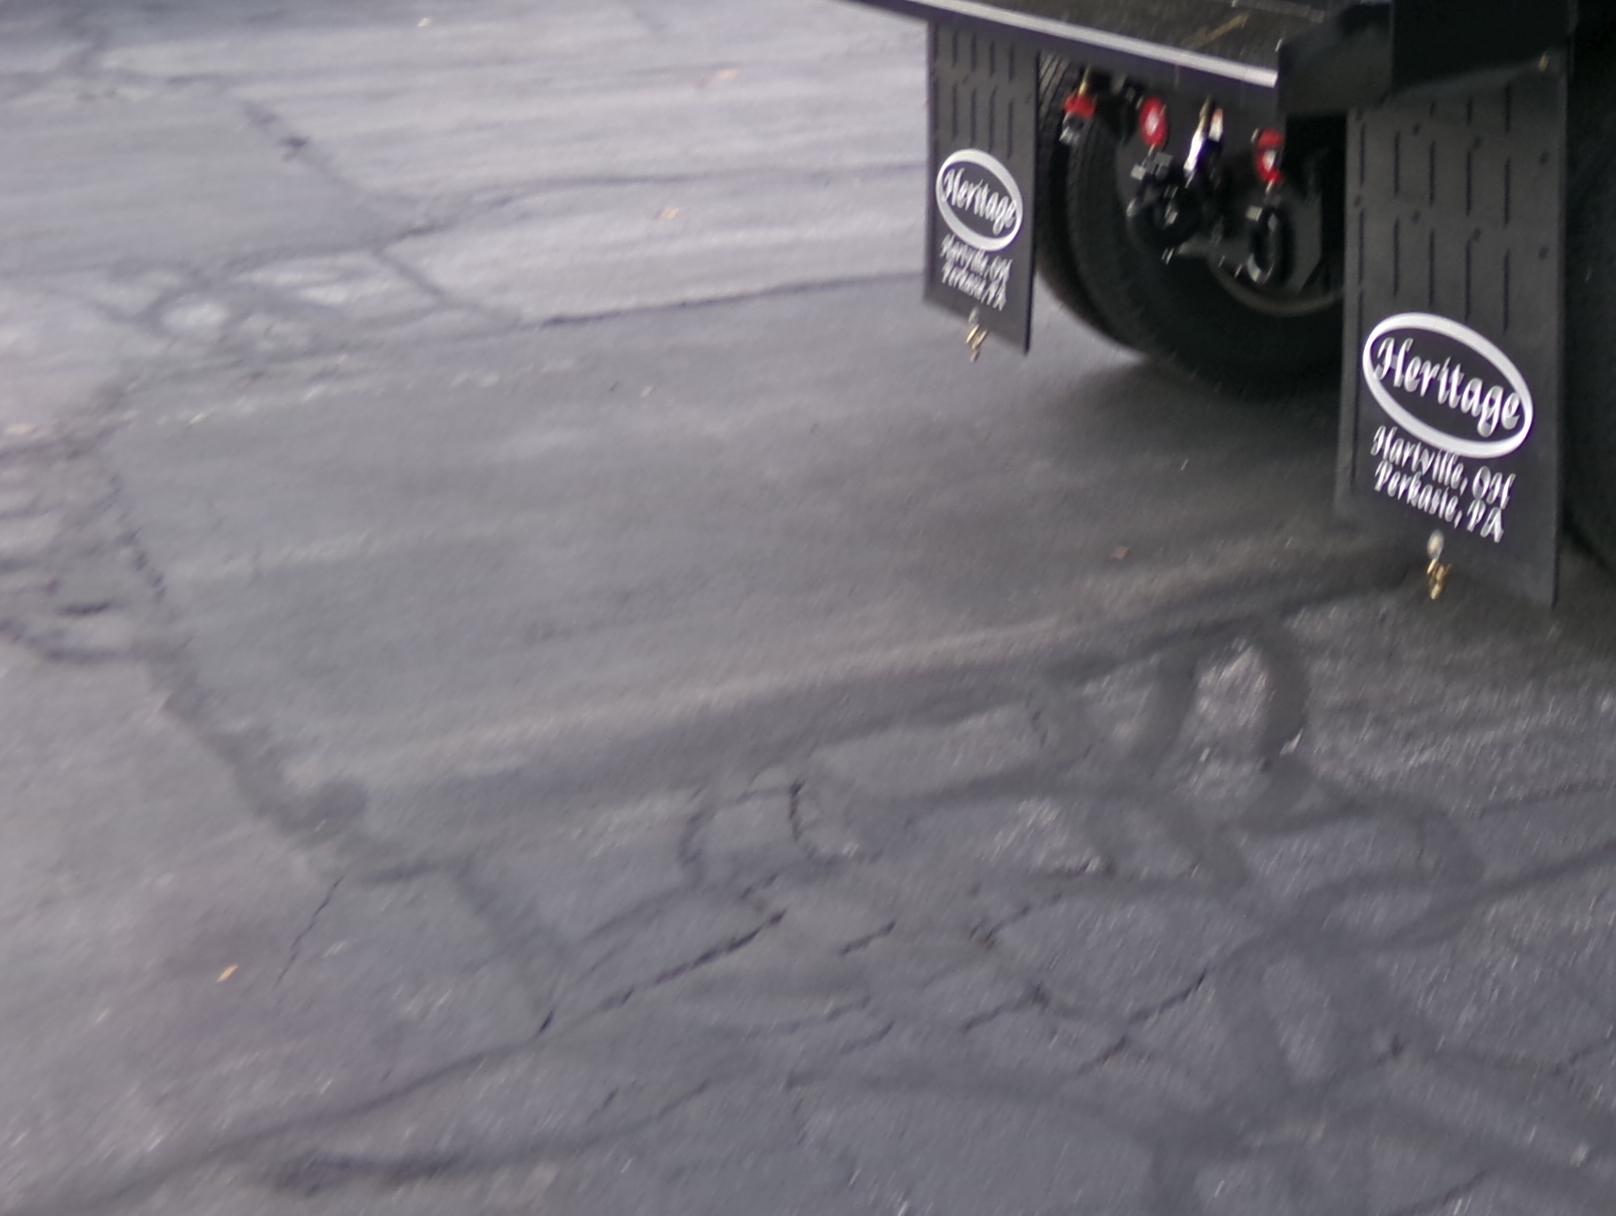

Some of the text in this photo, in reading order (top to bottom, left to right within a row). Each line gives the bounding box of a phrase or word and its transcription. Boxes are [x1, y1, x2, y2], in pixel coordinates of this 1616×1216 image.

[942, 168, 1017, 235] Heritage
[1375, 337, 1521, 437] Heritage
[1370, 425, 1516, 510] Hartville, OH
[1374, 460, 1504, 543] Perkasie, PA
